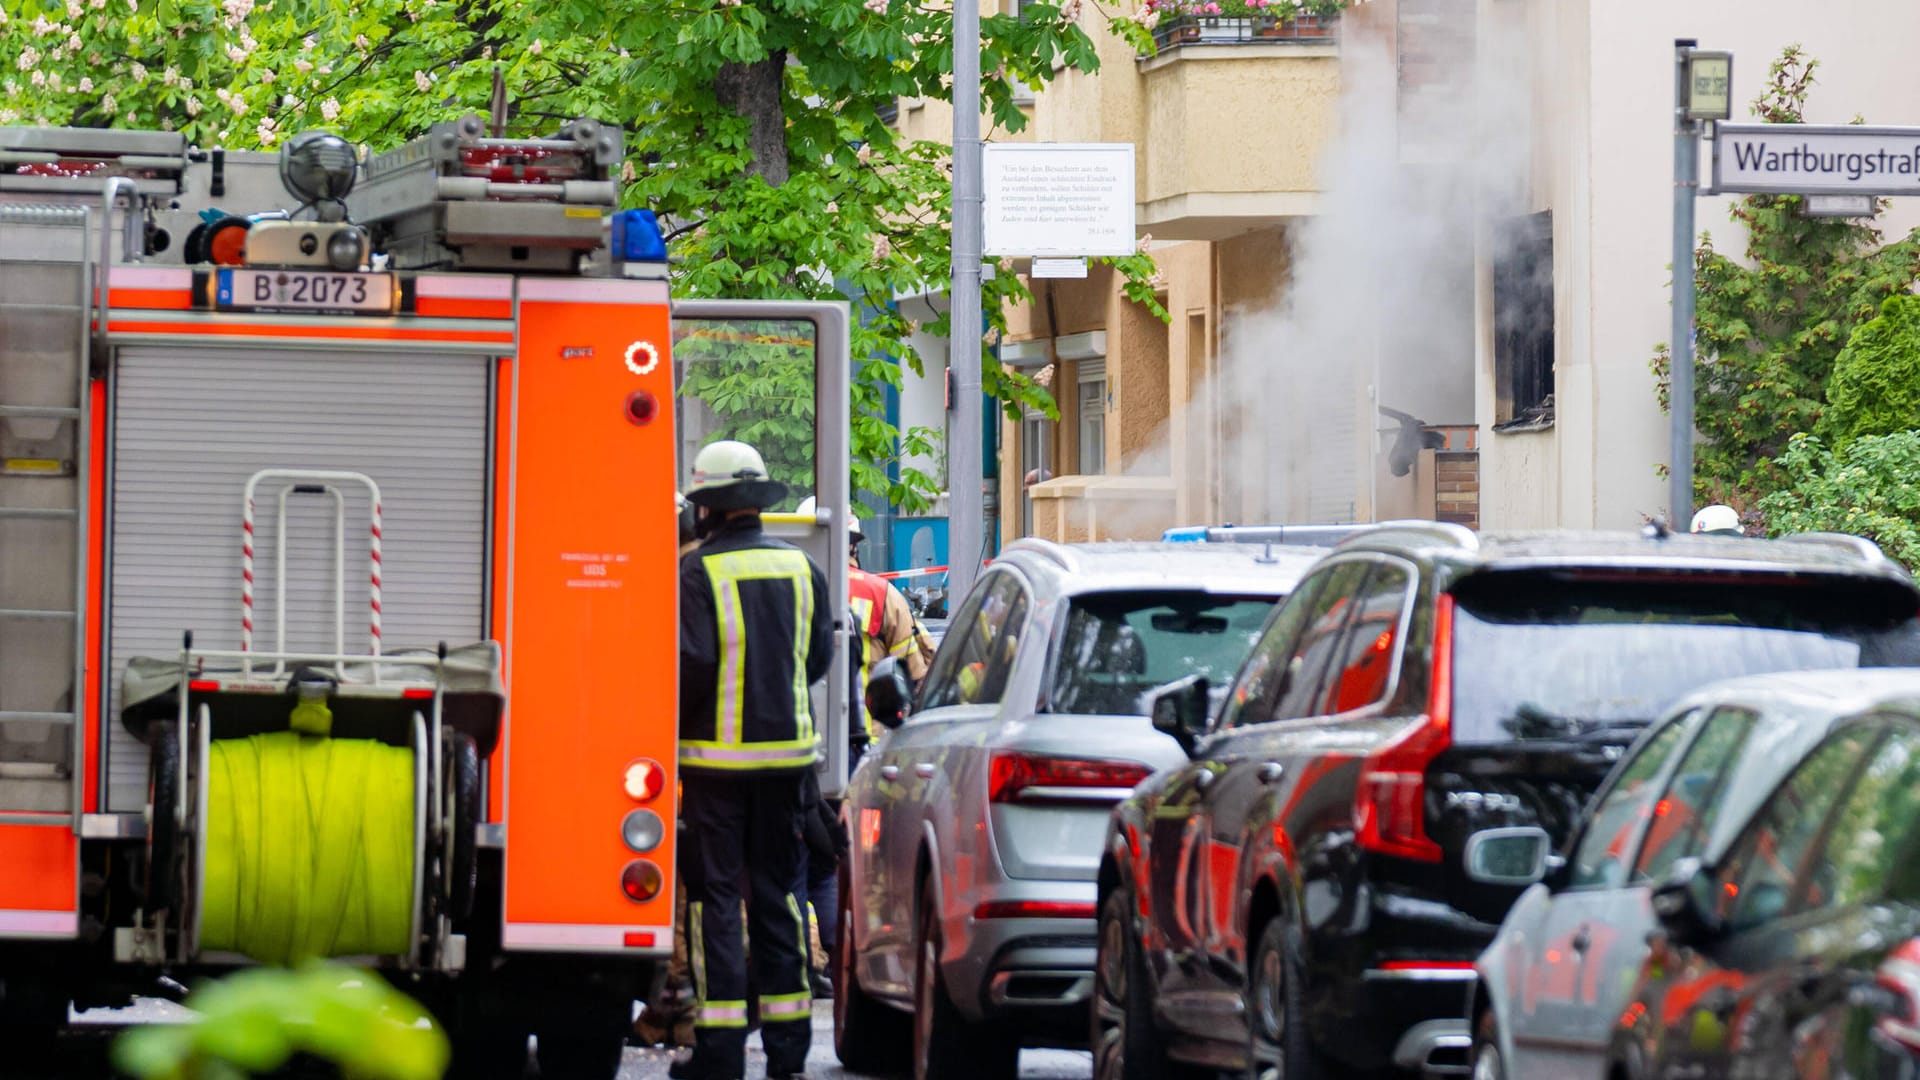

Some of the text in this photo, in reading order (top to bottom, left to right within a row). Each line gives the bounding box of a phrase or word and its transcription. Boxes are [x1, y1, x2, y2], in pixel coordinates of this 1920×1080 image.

[254, 274, 368, 304] B 2073
[583, 563, 607, 576] UDS
